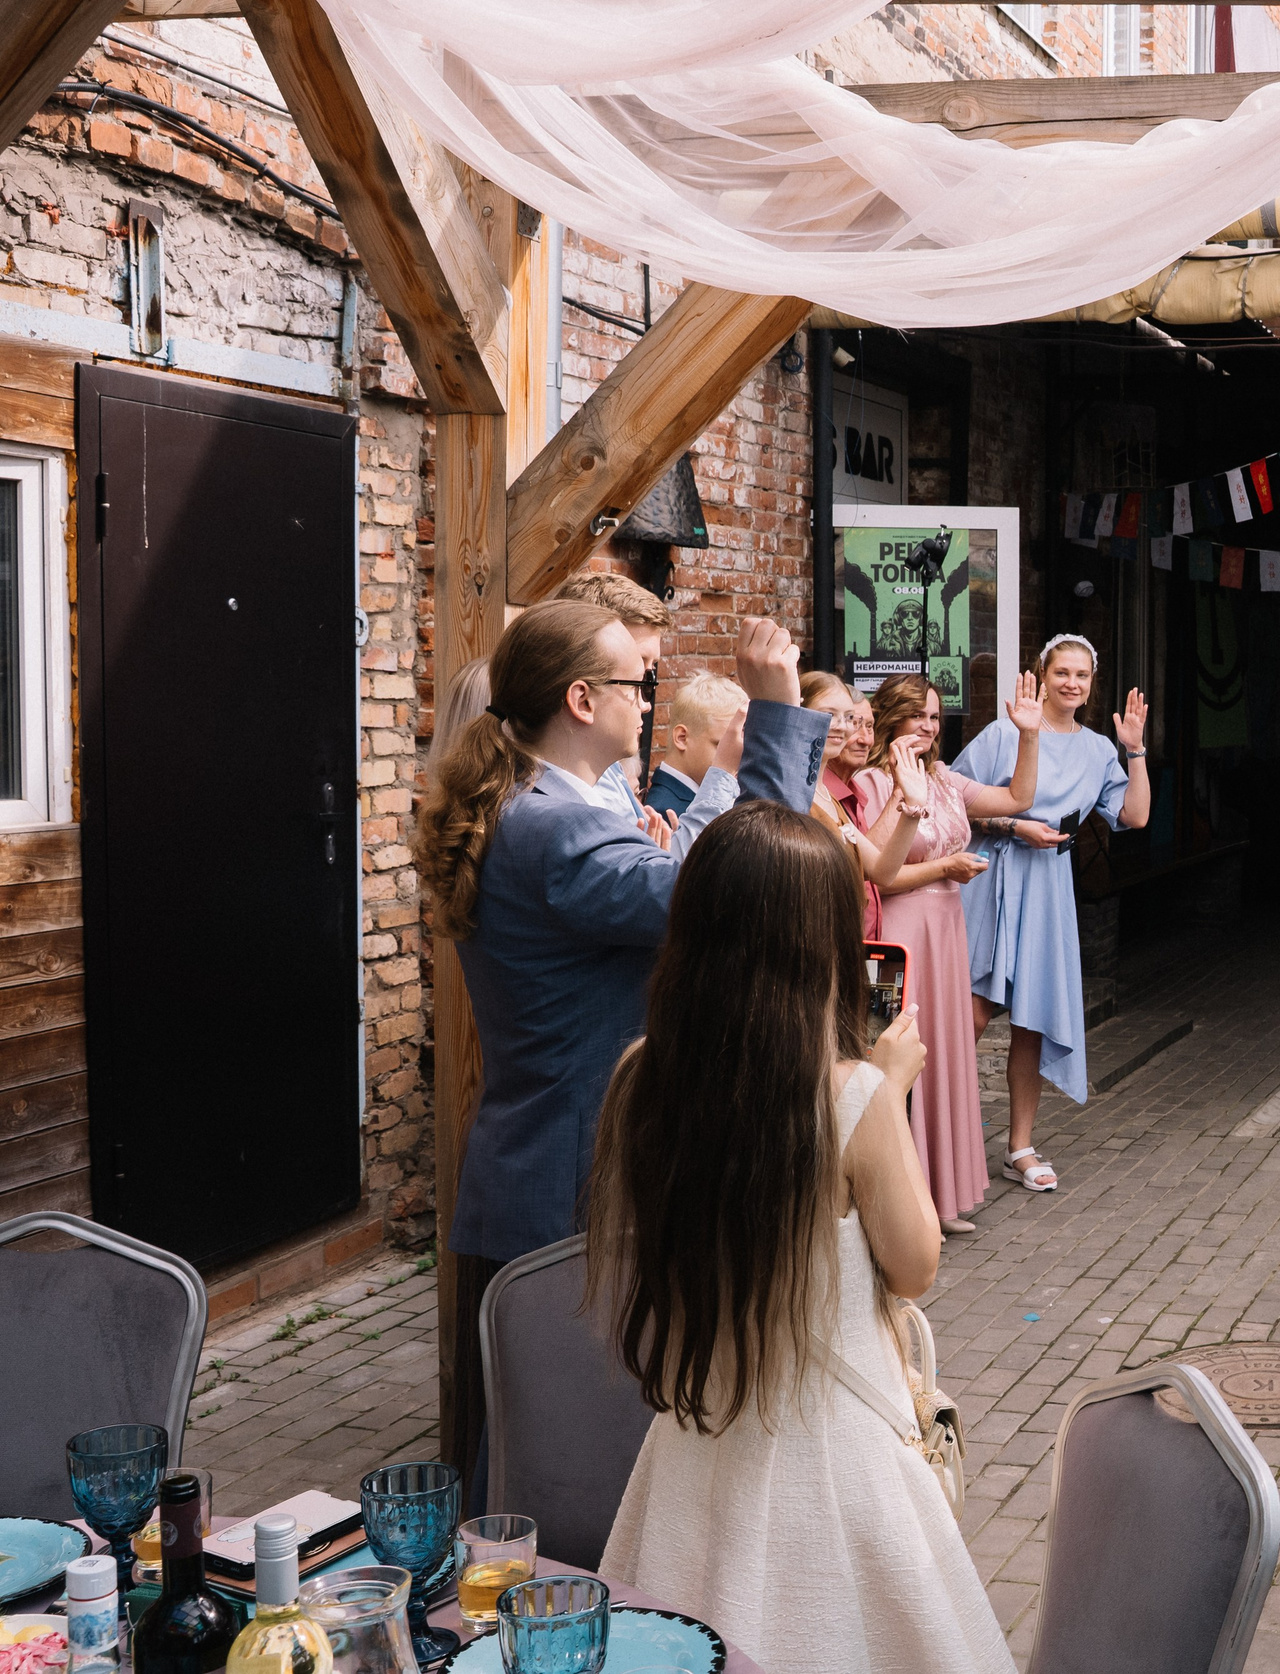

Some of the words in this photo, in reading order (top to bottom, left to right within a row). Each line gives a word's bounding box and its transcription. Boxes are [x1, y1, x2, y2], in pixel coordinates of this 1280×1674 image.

[845, 426, 894, 484] BAR
[871, 564, 946, 583] ТОПА
[856, 661, 921, 671] НЕЙРОМАНЦЕ
[933, 661, 959, 673] МОСКВА
